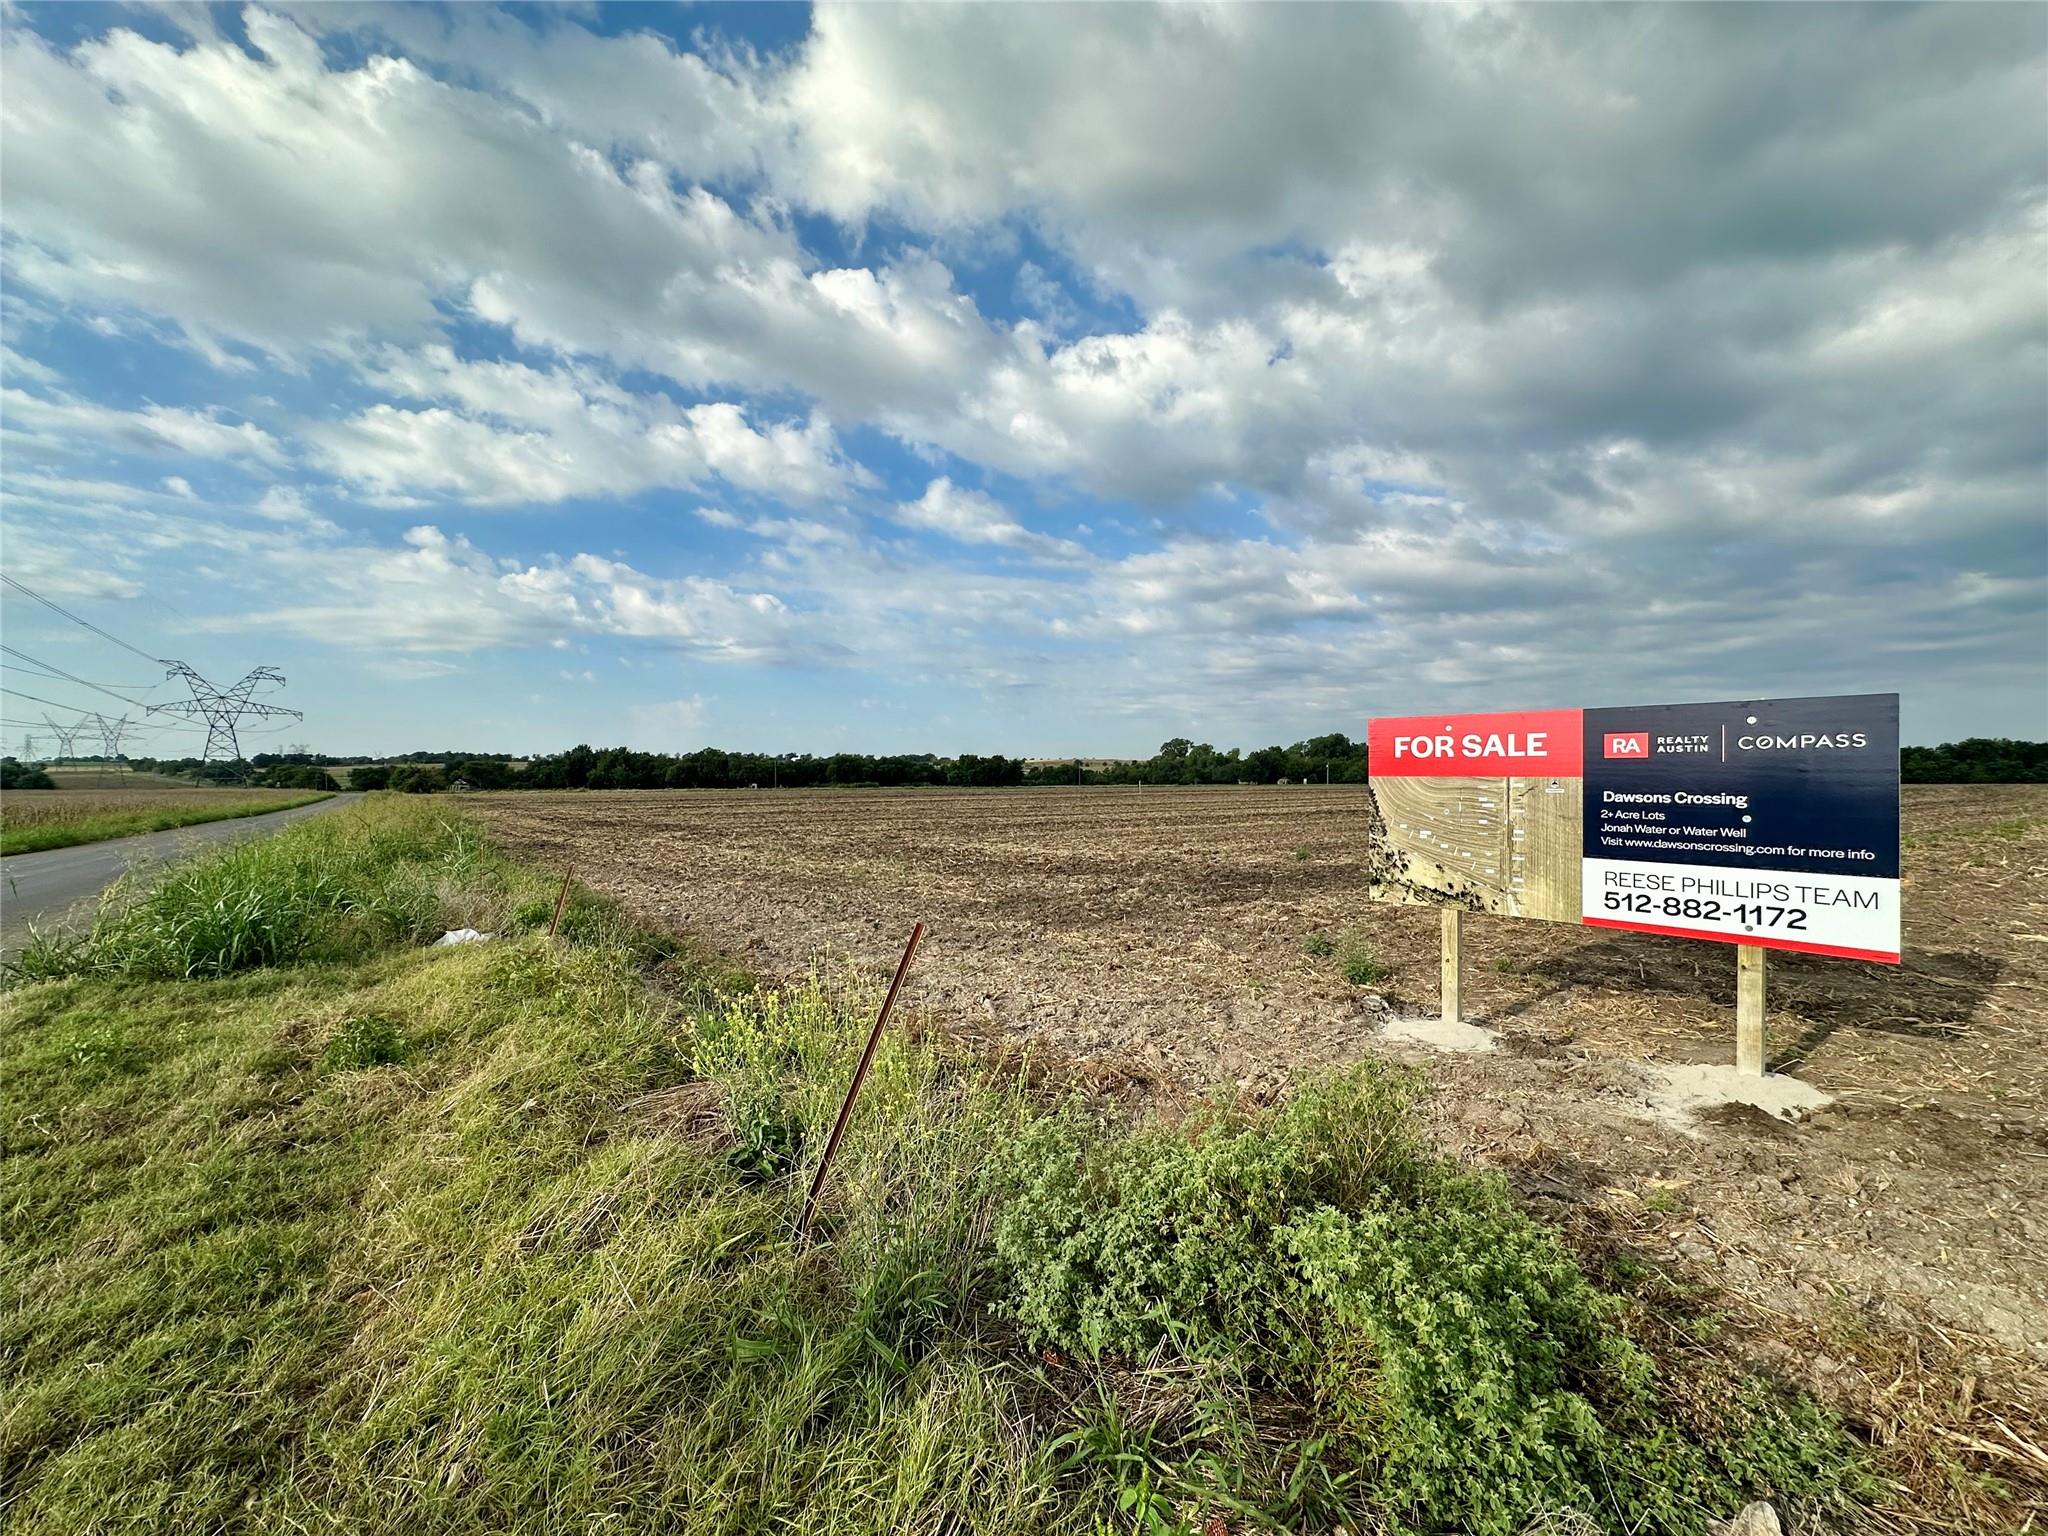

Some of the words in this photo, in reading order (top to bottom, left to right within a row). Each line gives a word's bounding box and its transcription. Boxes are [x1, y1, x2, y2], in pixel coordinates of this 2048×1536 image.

[1394, 735, 1455, 758] FOR
[1460, 733, 1548, 757] SALE
[1612, 738, 1641, 753] RA
[1657, 736, 1709, 745] REALTY
[1657, 744, 1709, 753] AUSTIN
[1738, 733, 1867, 750] COMPASS
[1603, 791, 1671, 805] Dawsons
[1674, 792, 1748, 808] Crossing
[1601, 810, 1613, 819] 2+
[1615, 811, 1640, 820] Acre
[1642, 811, 1665, 820] Lots
[1601, 823, 1633, 834] Jonah
[1635, 824, 1666, 835] Water
[1668, 827, 1681, 835] or
[1683, 826, 1718, 837] Water
[1720, 827, 1746, 838] Well
[1601, 837, 1623, 847] Visit
[1624, 839, 1785, 856] www.dawsonscrossing.com
[1787, 845, 1806, 856] for
[1809, 848, 1844, 859] more
[1847, 849, 1875, 861] info
[1604, 871, 1676, 891] REESE
[1681, 877, 1790, 901] PHILLIPS
[1794, 885, 1880, 910] TEAM
[1604, 891, 1808, 930] 512-882-1172
